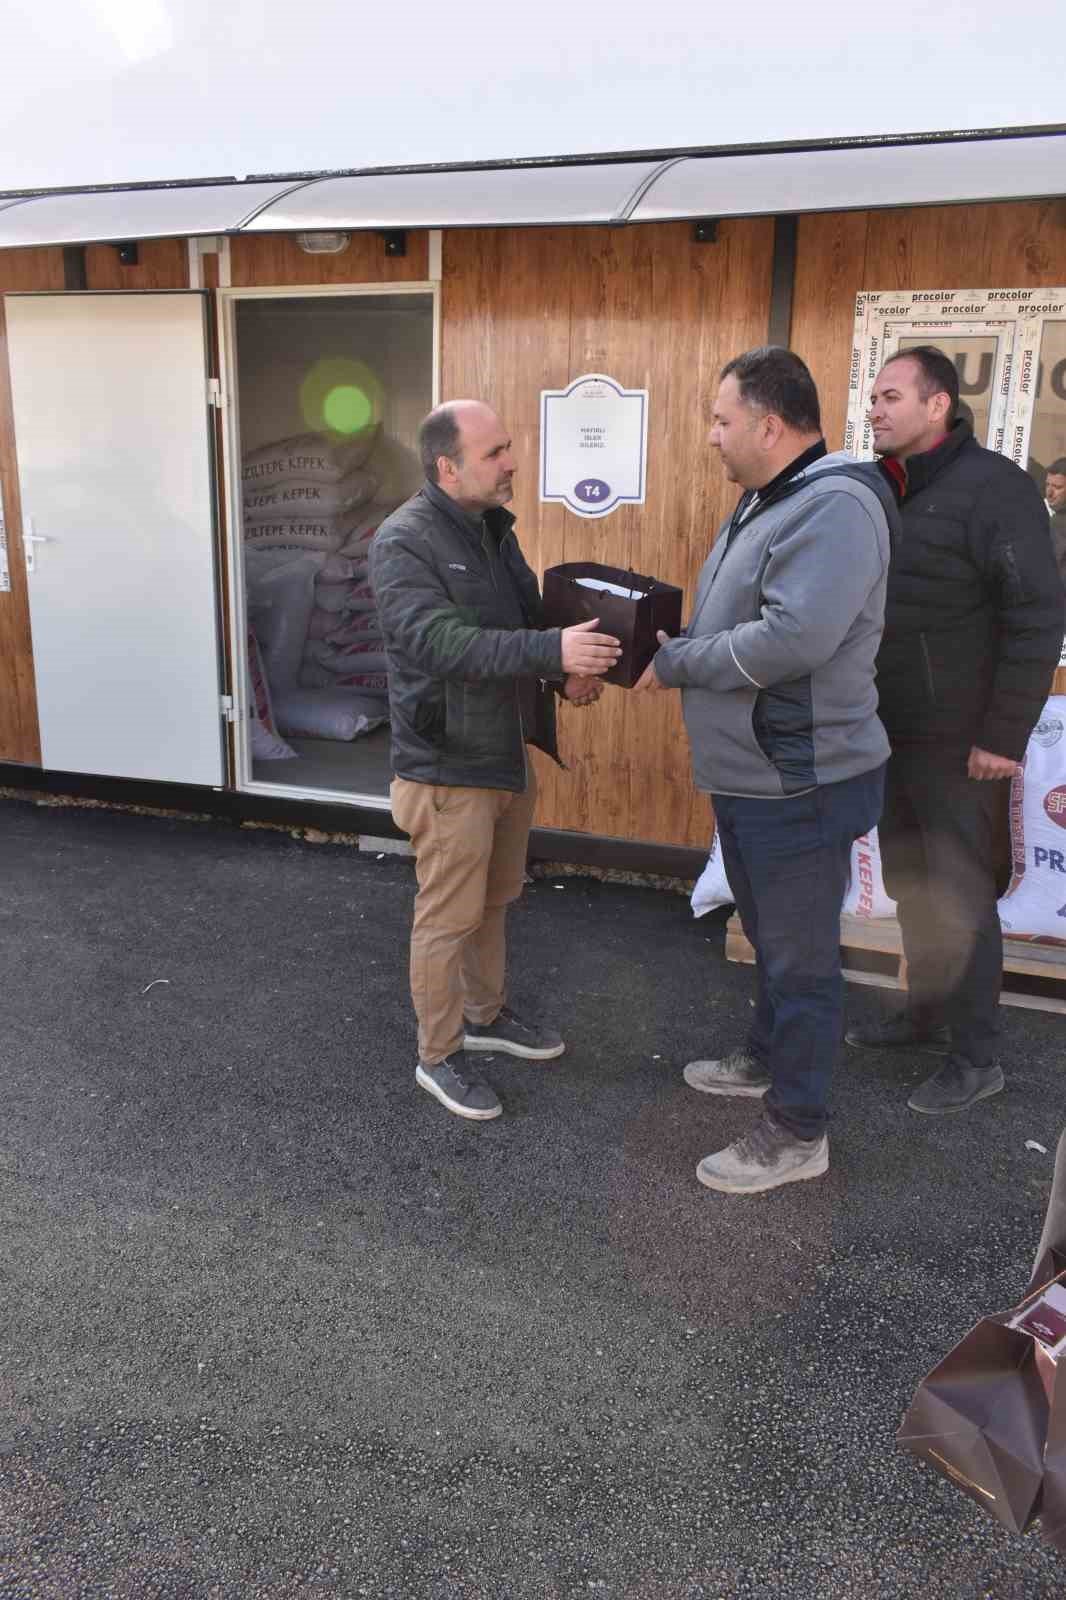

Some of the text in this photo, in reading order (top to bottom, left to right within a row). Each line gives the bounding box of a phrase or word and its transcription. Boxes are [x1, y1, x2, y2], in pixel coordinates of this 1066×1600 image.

[912, 291, 956, 302] procolor
[988, 290, 1032, 301] procolor
[941, 304, 986, 314] procolor
[1018, 303, 1064, 314] procolor
[869, 336, 878, 378] procolor
[850, 348, 862, 389] procolor
[1020, 350, 1033, 394] procolor
[1014, 425, 1024, 464] procolo
[584, 485, 600, 497] T4
